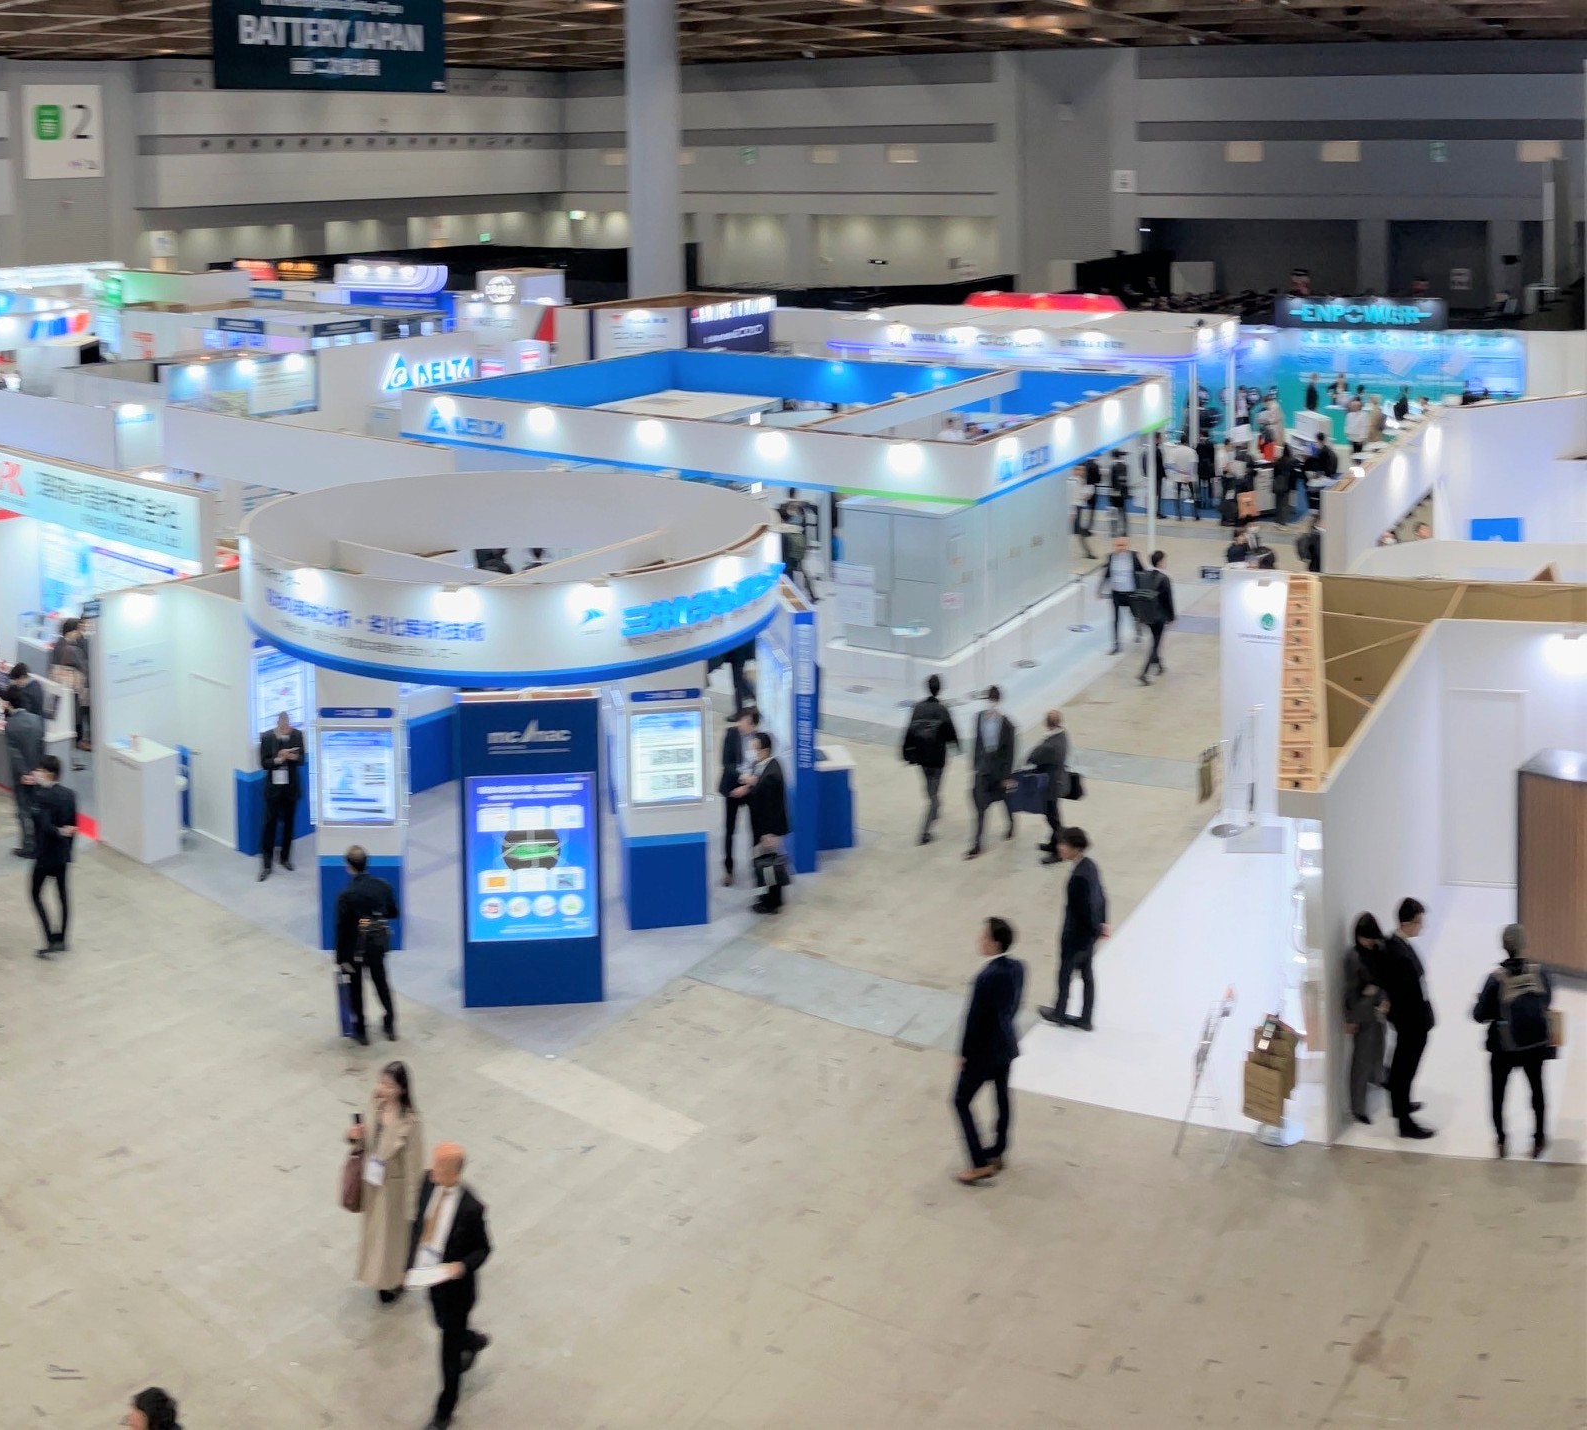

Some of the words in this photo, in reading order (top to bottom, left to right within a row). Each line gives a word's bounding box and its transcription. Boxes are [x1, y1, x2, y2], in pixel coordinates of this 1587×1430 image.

[238, 14, 350, 48] BATTERY
[350, 20, 425, 51] JAPAN
[71, 104, 94, 139] 2
[413, 355, 474, 387] DELTA
